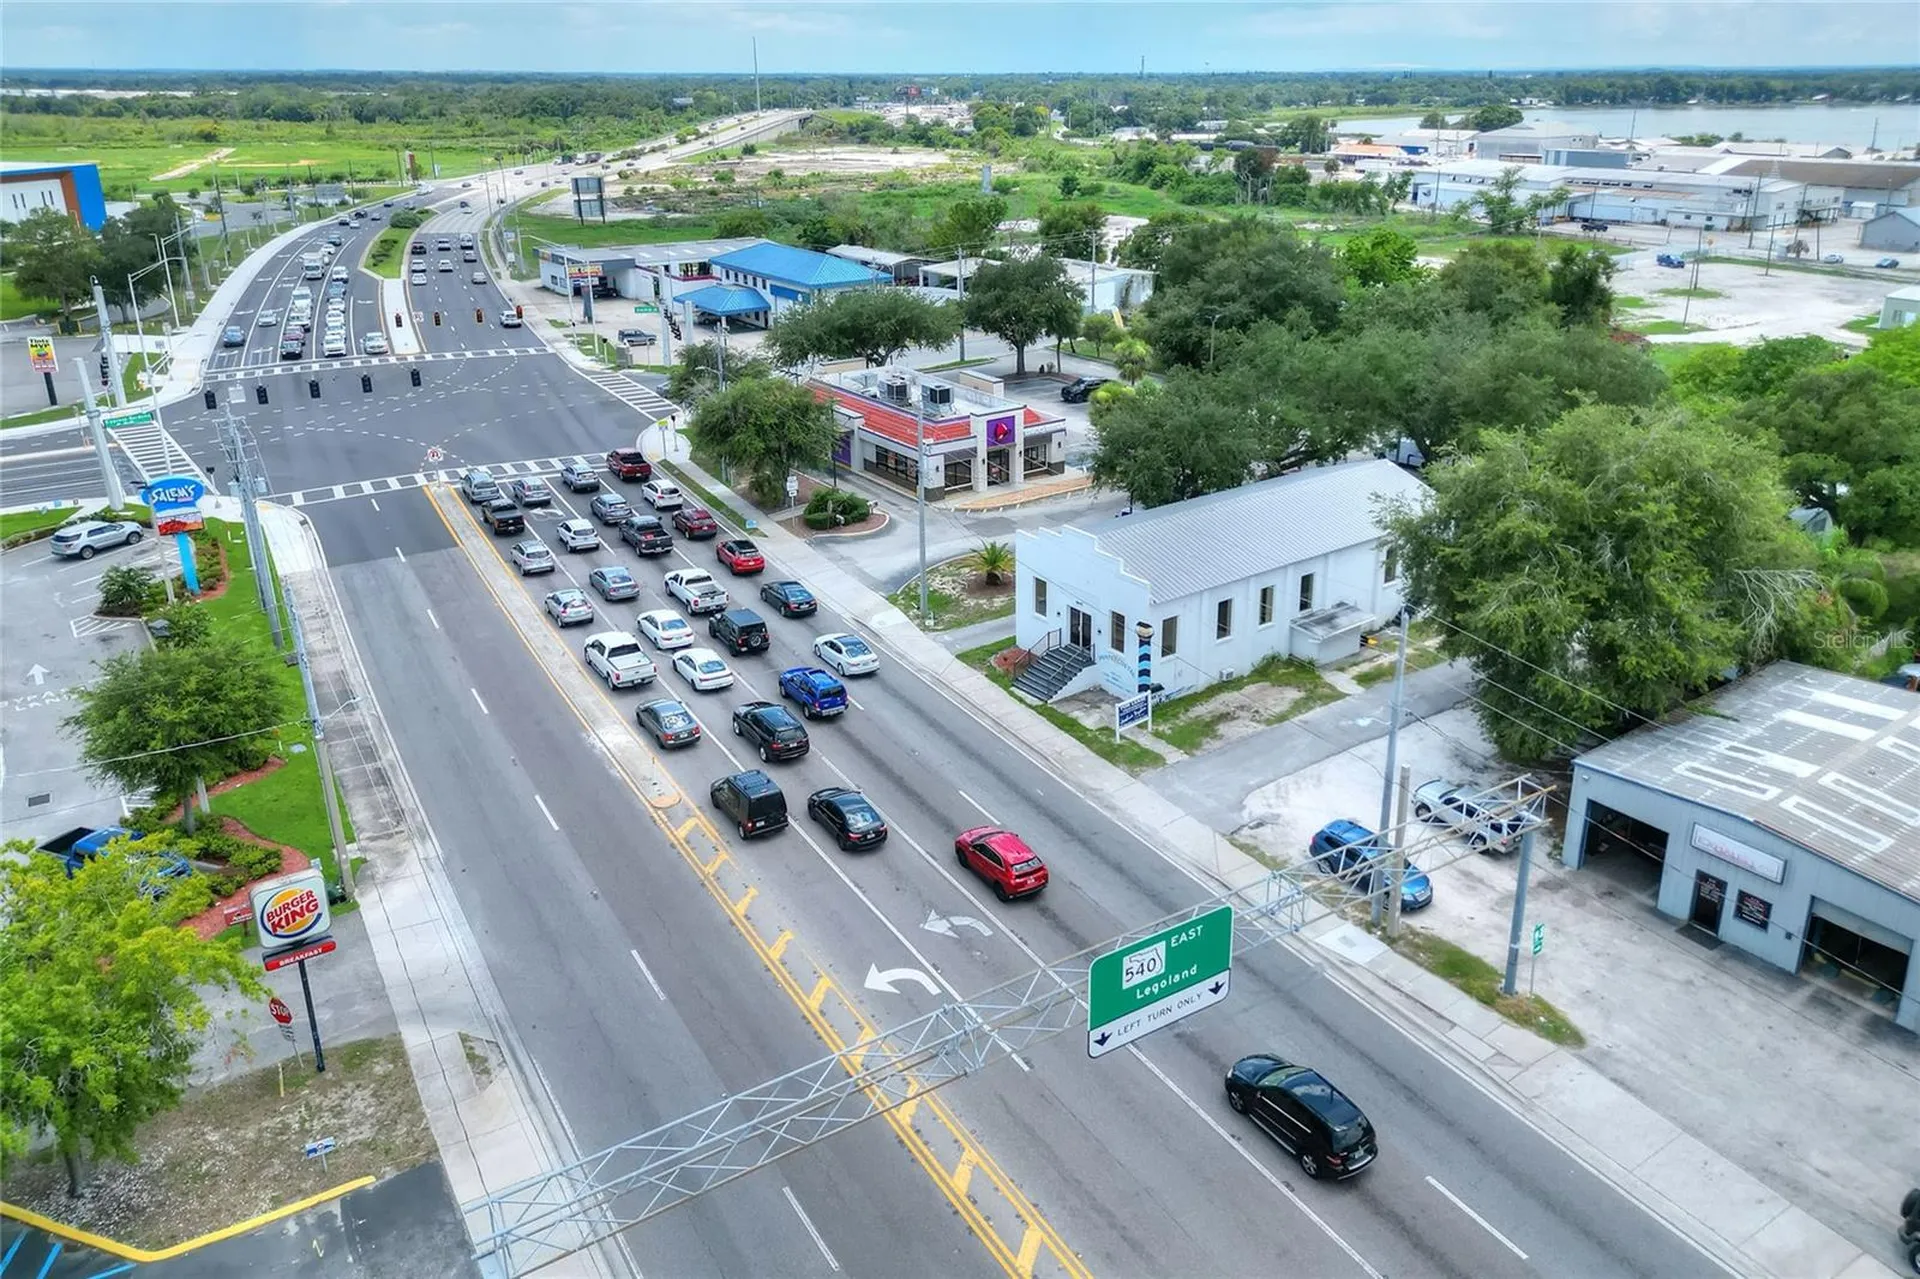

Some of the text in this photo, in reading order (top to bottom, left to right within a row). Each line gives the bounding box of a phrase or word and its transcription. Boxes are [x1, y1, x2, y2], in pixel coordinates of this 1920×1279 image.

[151, 484, 196, 504] SALEM'S
[266, 889, 315, 923] BURGER
[269, 899, 319, 935] KING
[1170, 924, 1204, 948] EAST
[279, 947, 324, 967] BREAKFAST
[1125, 957, 1158, 984] 540
[1135, 963, 1198, 999] Legoland
[1116, 991, 1203, 1037] LEFT TURN ONLY
